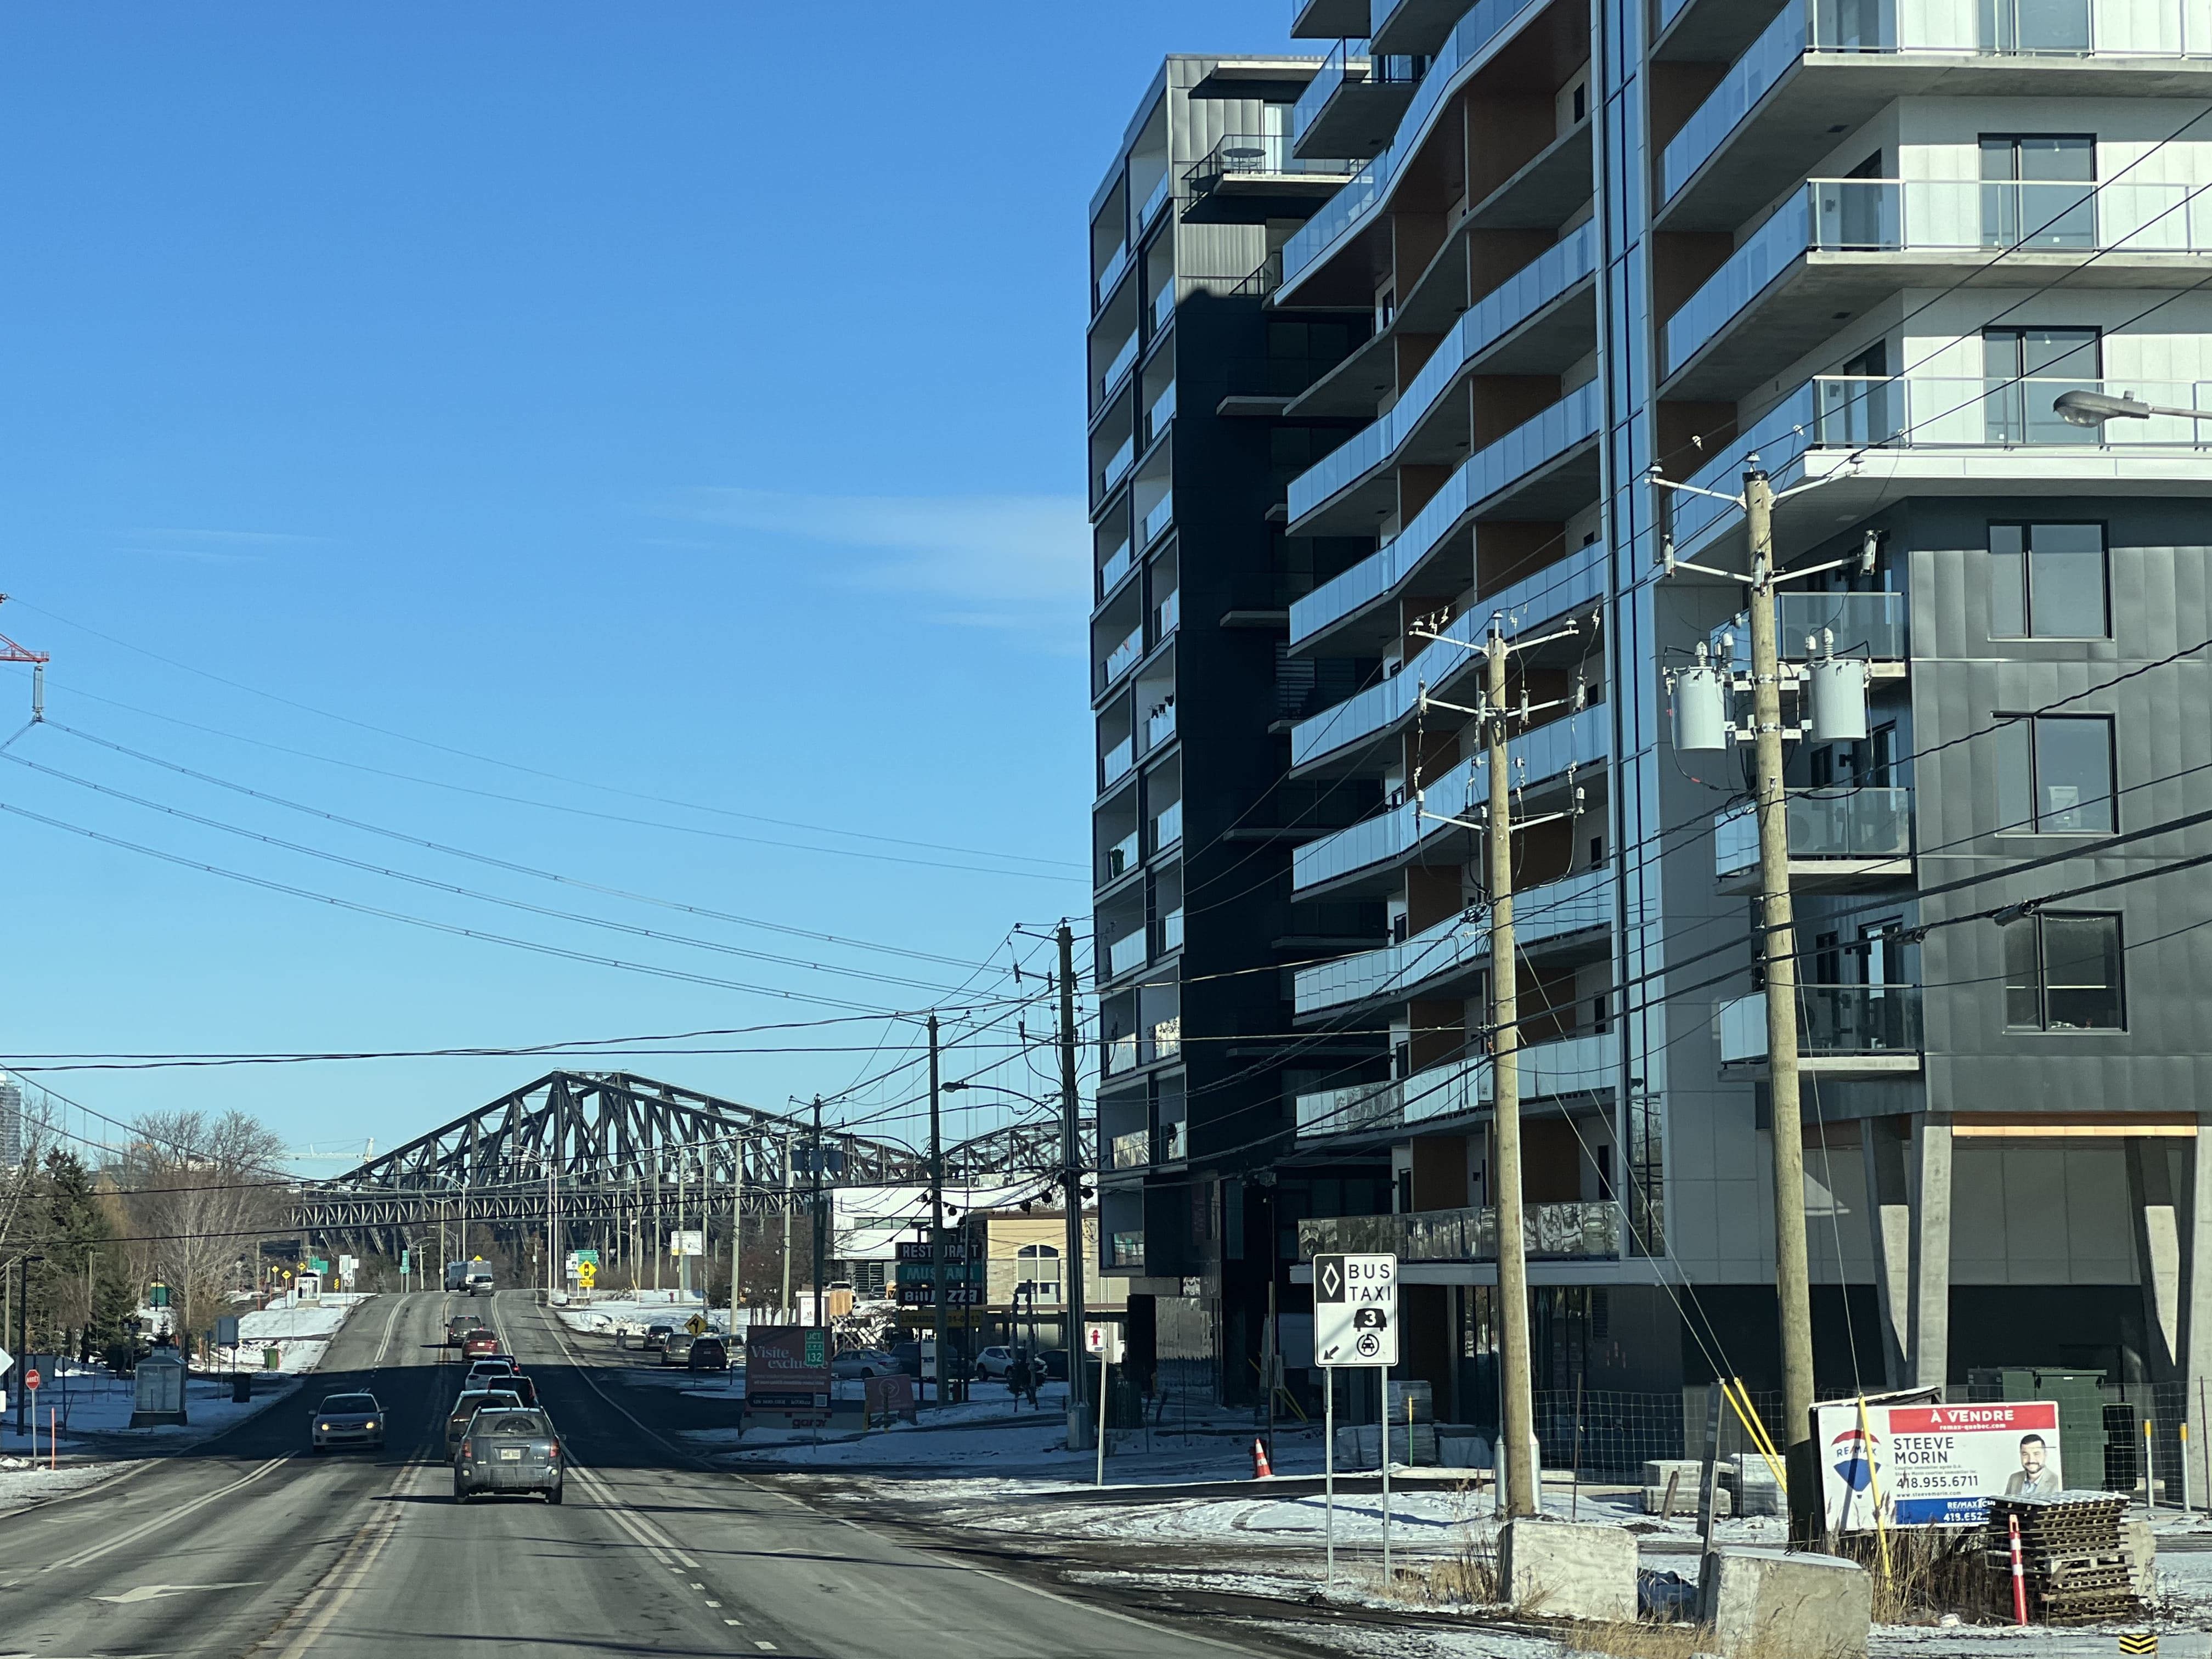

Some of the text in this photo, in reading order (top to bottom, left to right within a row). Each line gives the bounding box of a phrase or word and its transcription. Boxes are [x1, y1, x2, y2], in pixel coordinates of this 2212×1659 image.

[1349, 1264, 1390, 1279] BUS
[1349, 1286, 1391, 1301] TAXI
[1364, 1310, 1376, 1326] 3
[751, 1346, 789, 1358] Visite
[807, 1353, 822, 1362] 132
[1931, 1409, 2015, 1423] À VENDRE
[1893, 1437, 1954, 1450] STEEVE
[1894, 1451, 1948, 1464] MORIN
[1897, 1475, 1978, 1489] 418.955.6711
[1947, 1500, 1976, 1509] RE/MAX
